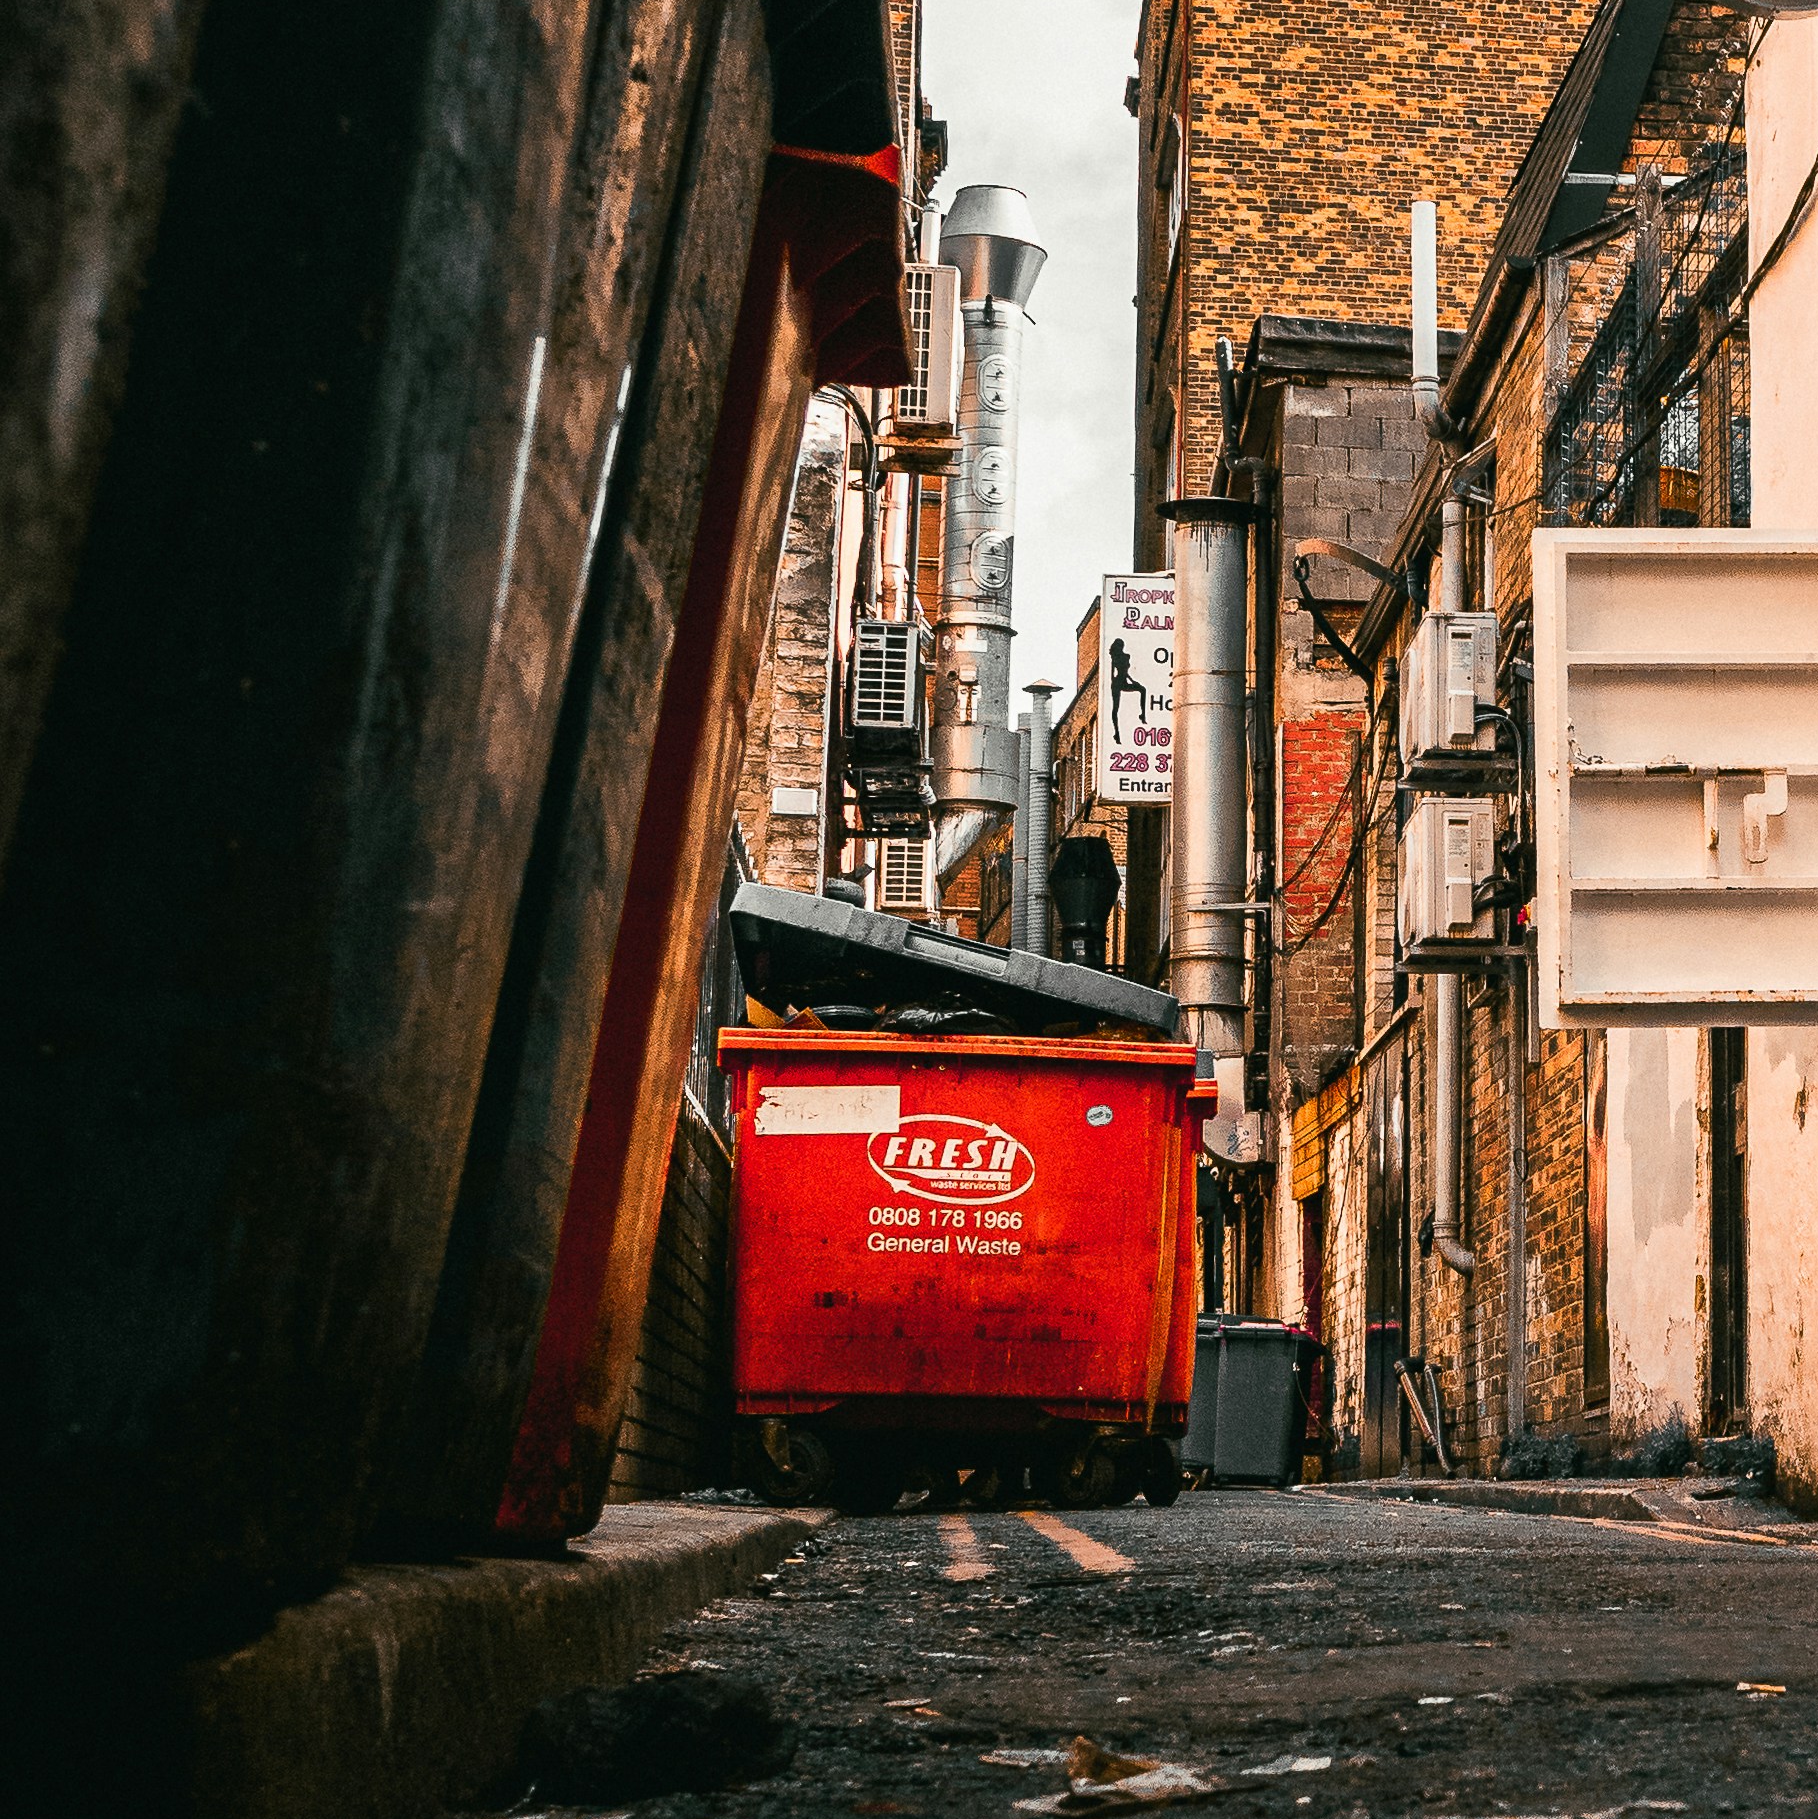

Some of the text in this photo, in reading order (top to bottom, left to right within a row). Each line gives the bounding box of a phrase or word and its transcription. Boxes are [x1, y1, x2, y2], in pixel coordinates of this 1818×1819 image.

[1110, 752, 1149, 772] 228
[883, 1136, 1018, 1170] FRESH
[930, 1181, 1011, 1191] waste services ltd
[869, 1206, 1023, 1230] 0808 178 1966
[867, 1232, 1022, 1256] General Waste
